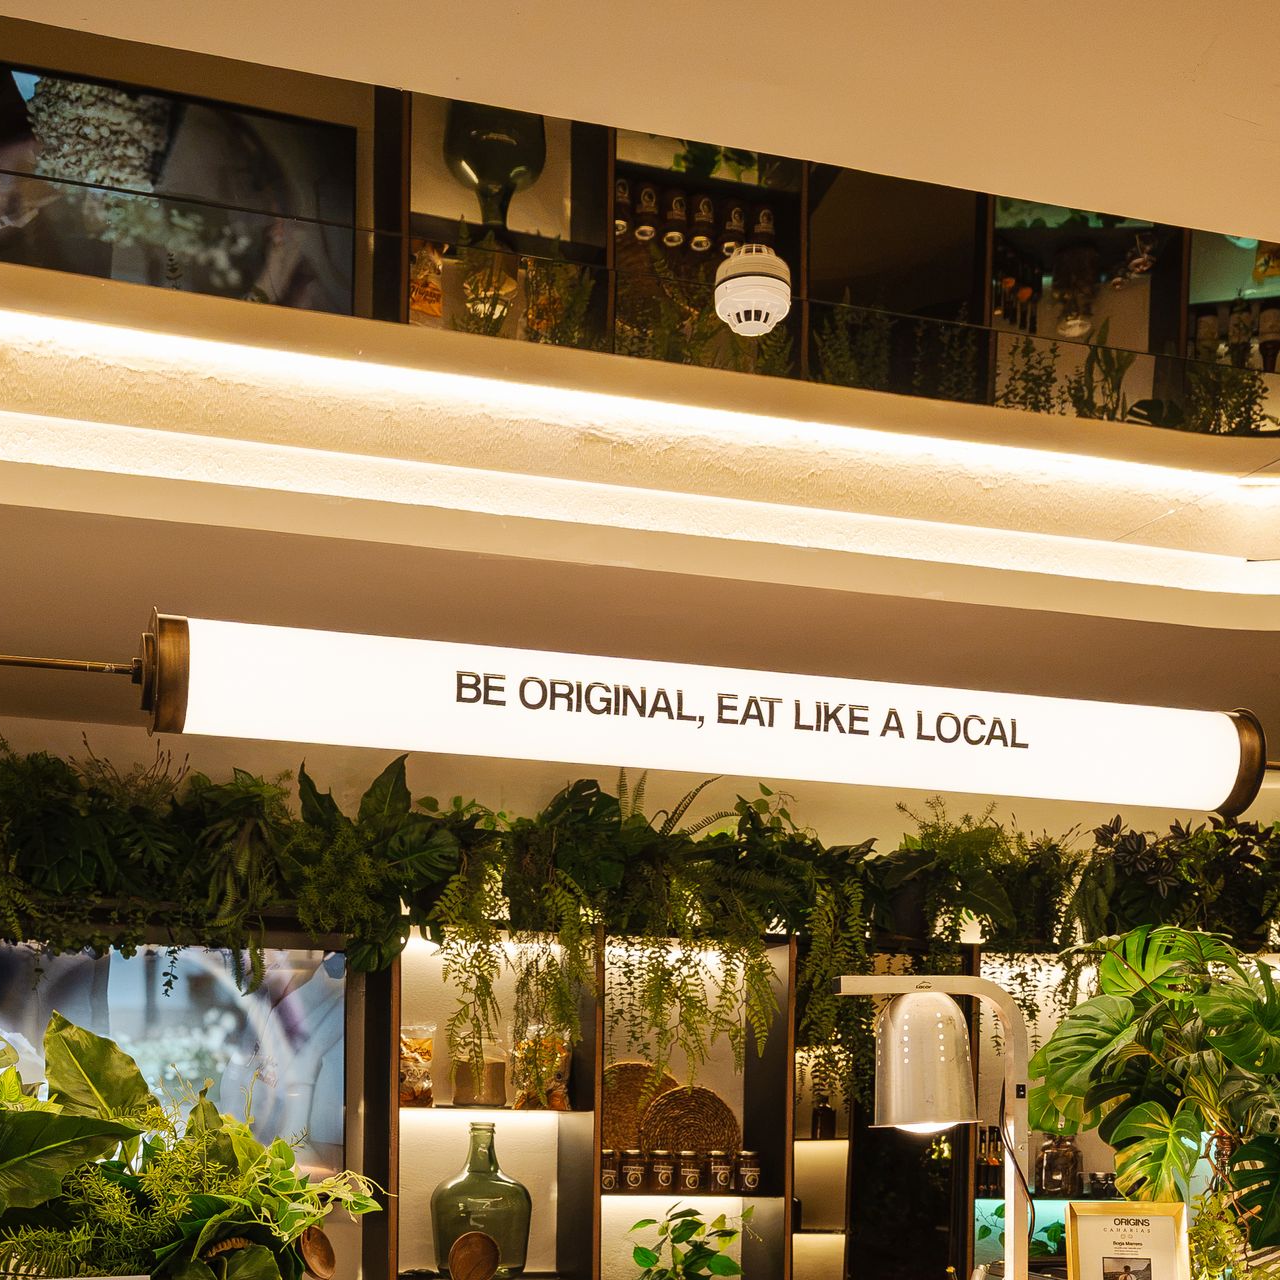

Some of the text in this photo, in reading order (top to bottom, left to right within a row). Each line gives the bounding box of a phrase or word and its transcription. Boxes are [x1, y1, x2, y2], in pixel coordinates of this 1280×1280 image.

[456, 671, 1028, 748] BE ORIGINAL, EAT LIKE A LOCAL
[1114, 1218, 1150, 1226] ORIGINS
